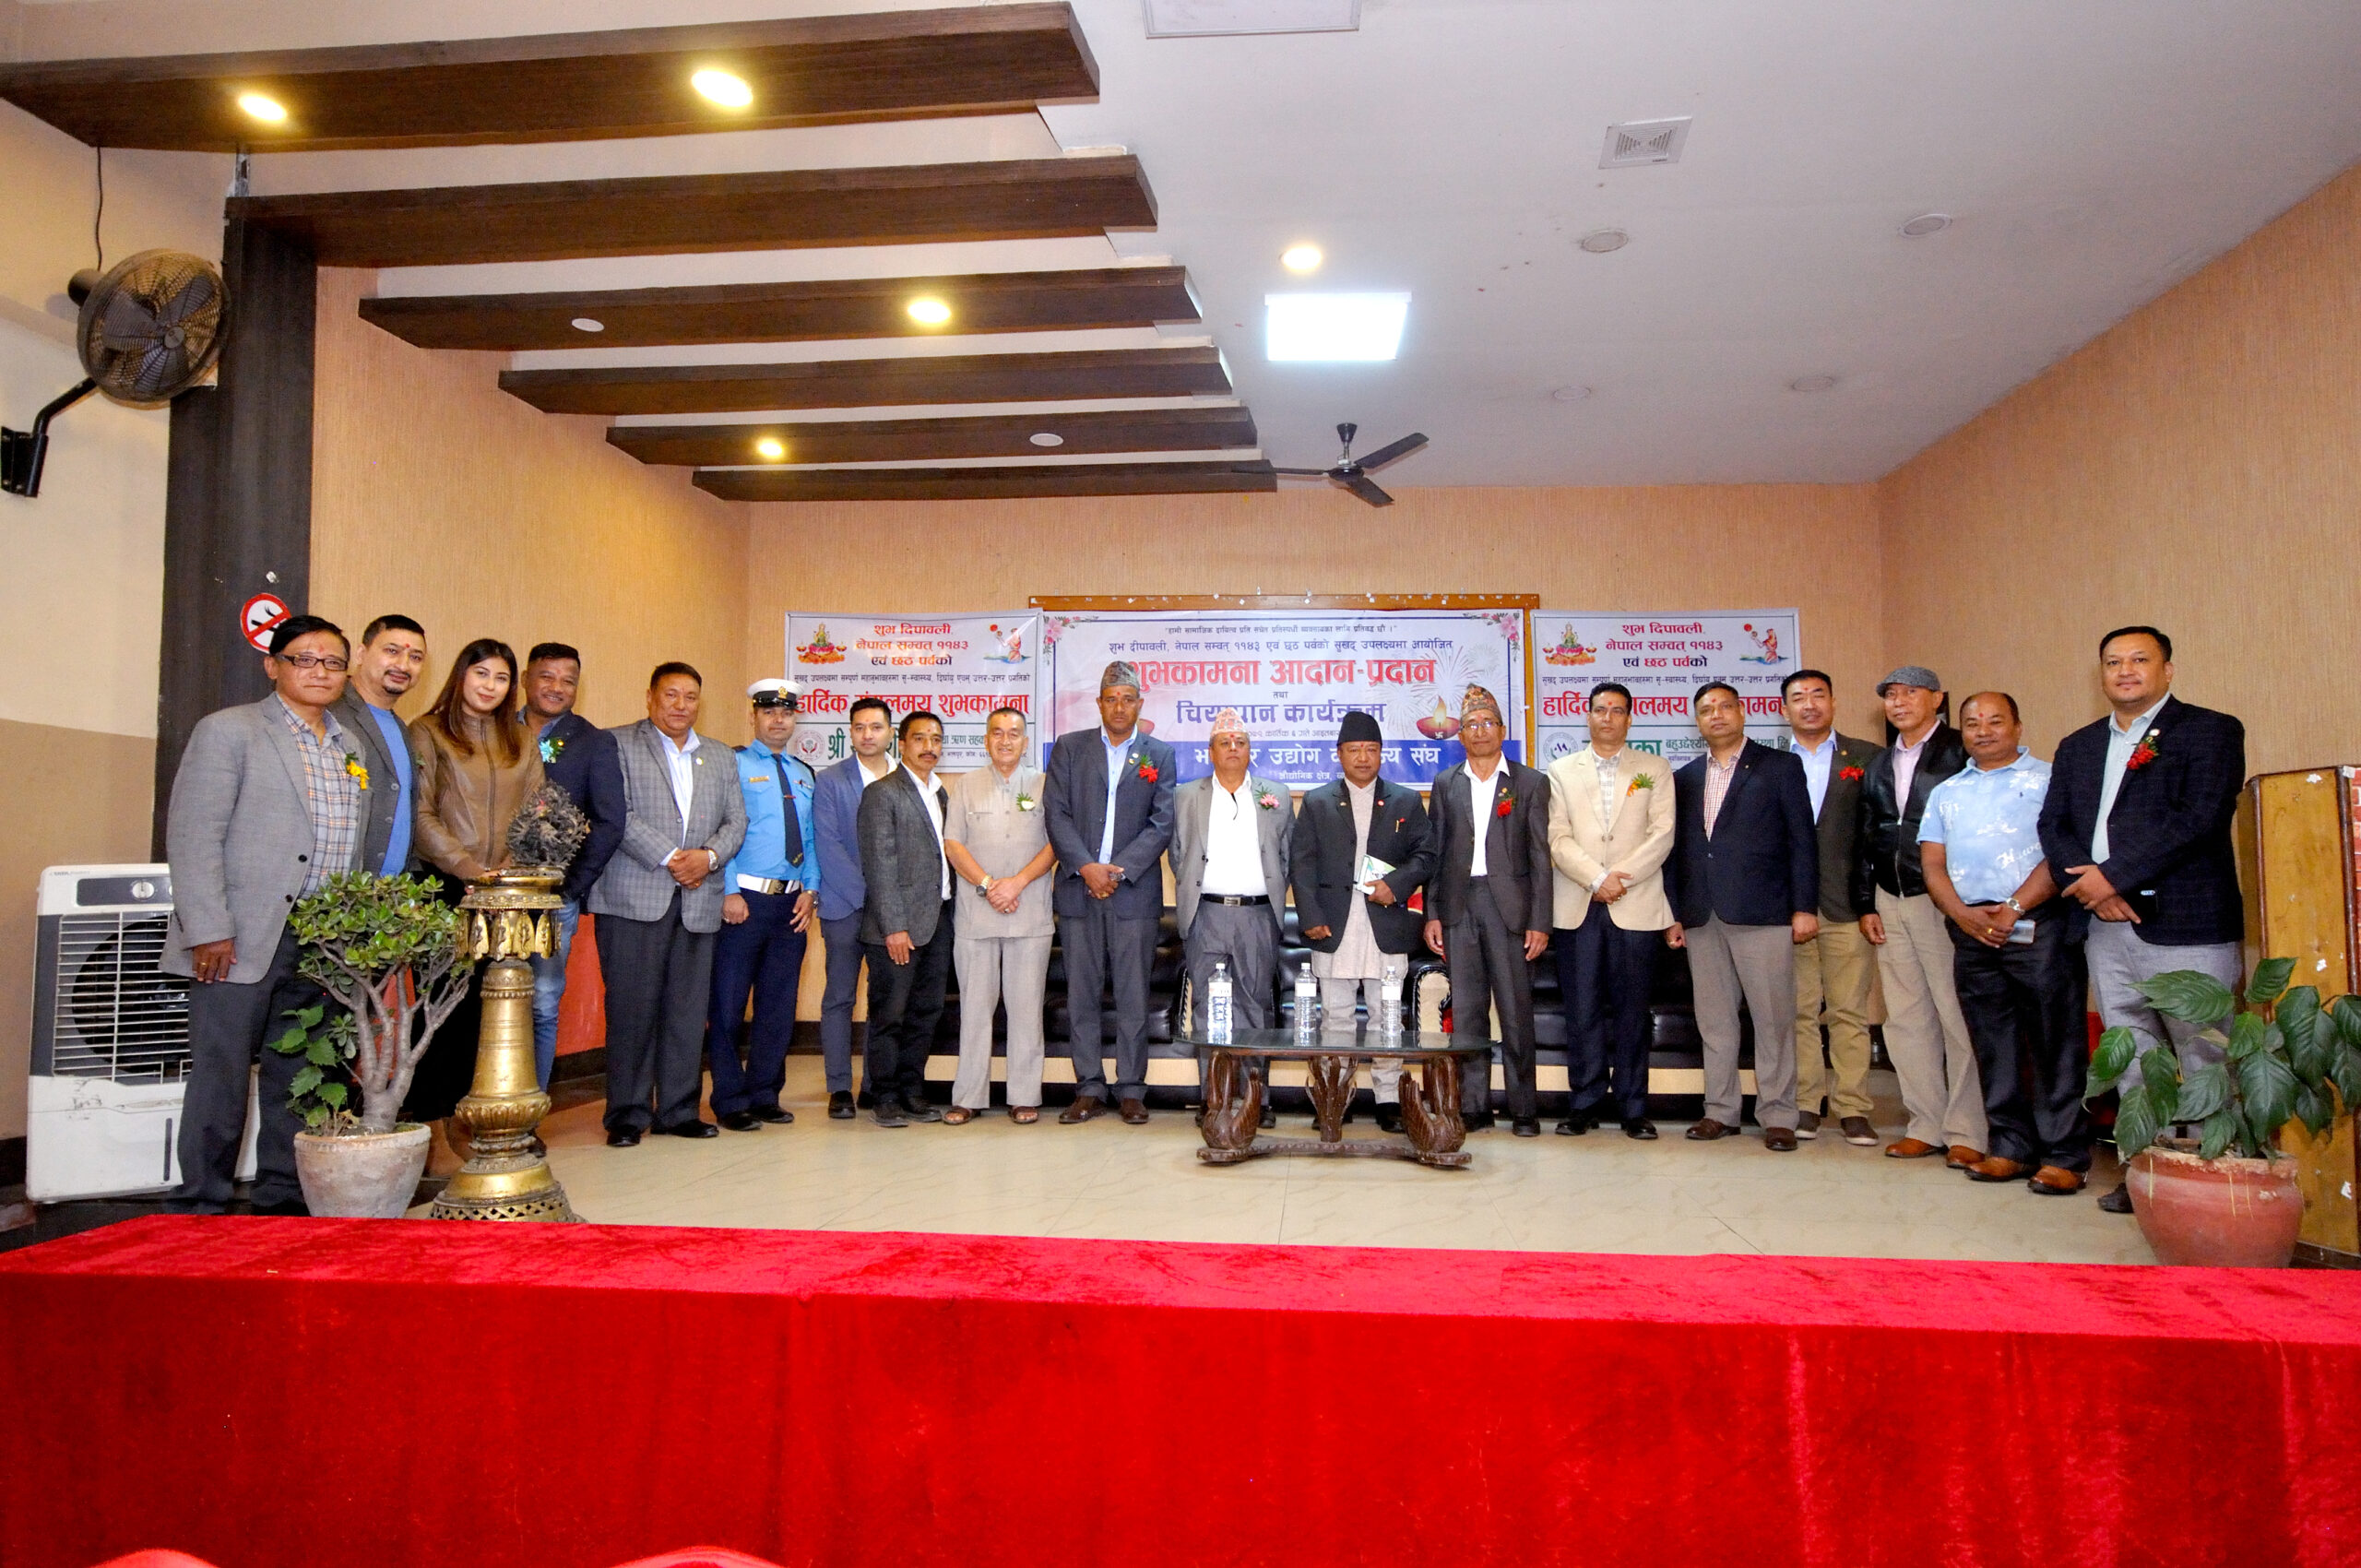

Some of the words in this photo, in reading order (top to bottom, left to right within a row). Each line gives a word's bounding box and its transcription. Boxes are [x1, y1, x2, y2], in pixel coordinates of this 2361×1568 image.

[873, 624, 896, 637] शुभ
[1185, 625, 1213, 634] सामाजिक
[1622, 624, 1644, 636] शुभ
[856, 637, 892, 650] नेपाल
[896, 640, 933, 651] सम्वत्
[937, 640, 968, 650] ११४३
[1109, 642, 1125, 654] शुभ
[1175, 640, 1199, 651] नेपाल
[1204, 642, 1229, 652] सम्वत्
[1234, 641, 1260, 652] ११४३
[1266, 639, 1280, 652] एवं
[1285, 641, 1299, 651] छठ
[1304, 638, 1329, 649] पर्वको
[1360, 640, 1407, 649] उपलक्ष्यमा
[1411, 637, 1453, 649] आयोजित
[1606, 638, 1643, 650] नेपाल
[1648, 641, 1687, 652] सम्वत्
[1690, 641, 1723, 650] ११४३
[871, 655, 886, 666] एवं
[891, 656, 914, 666] छठ
[919, 654, 953, 666] पर्वको
[1623, 656, 1639, 667] एवं
[1643, 658, 1667, 667] छठ
[1672, 655, 1707, 667] पर्वको
[794, 688, 848, 714] हार्दिक
[939, 695, 1029, 717] शुभकामना
[828, 727, 846, 761] श्री
[1268, 743, 1322, 766] उद्योग
[1409, 743, 1442, 766] संघ
